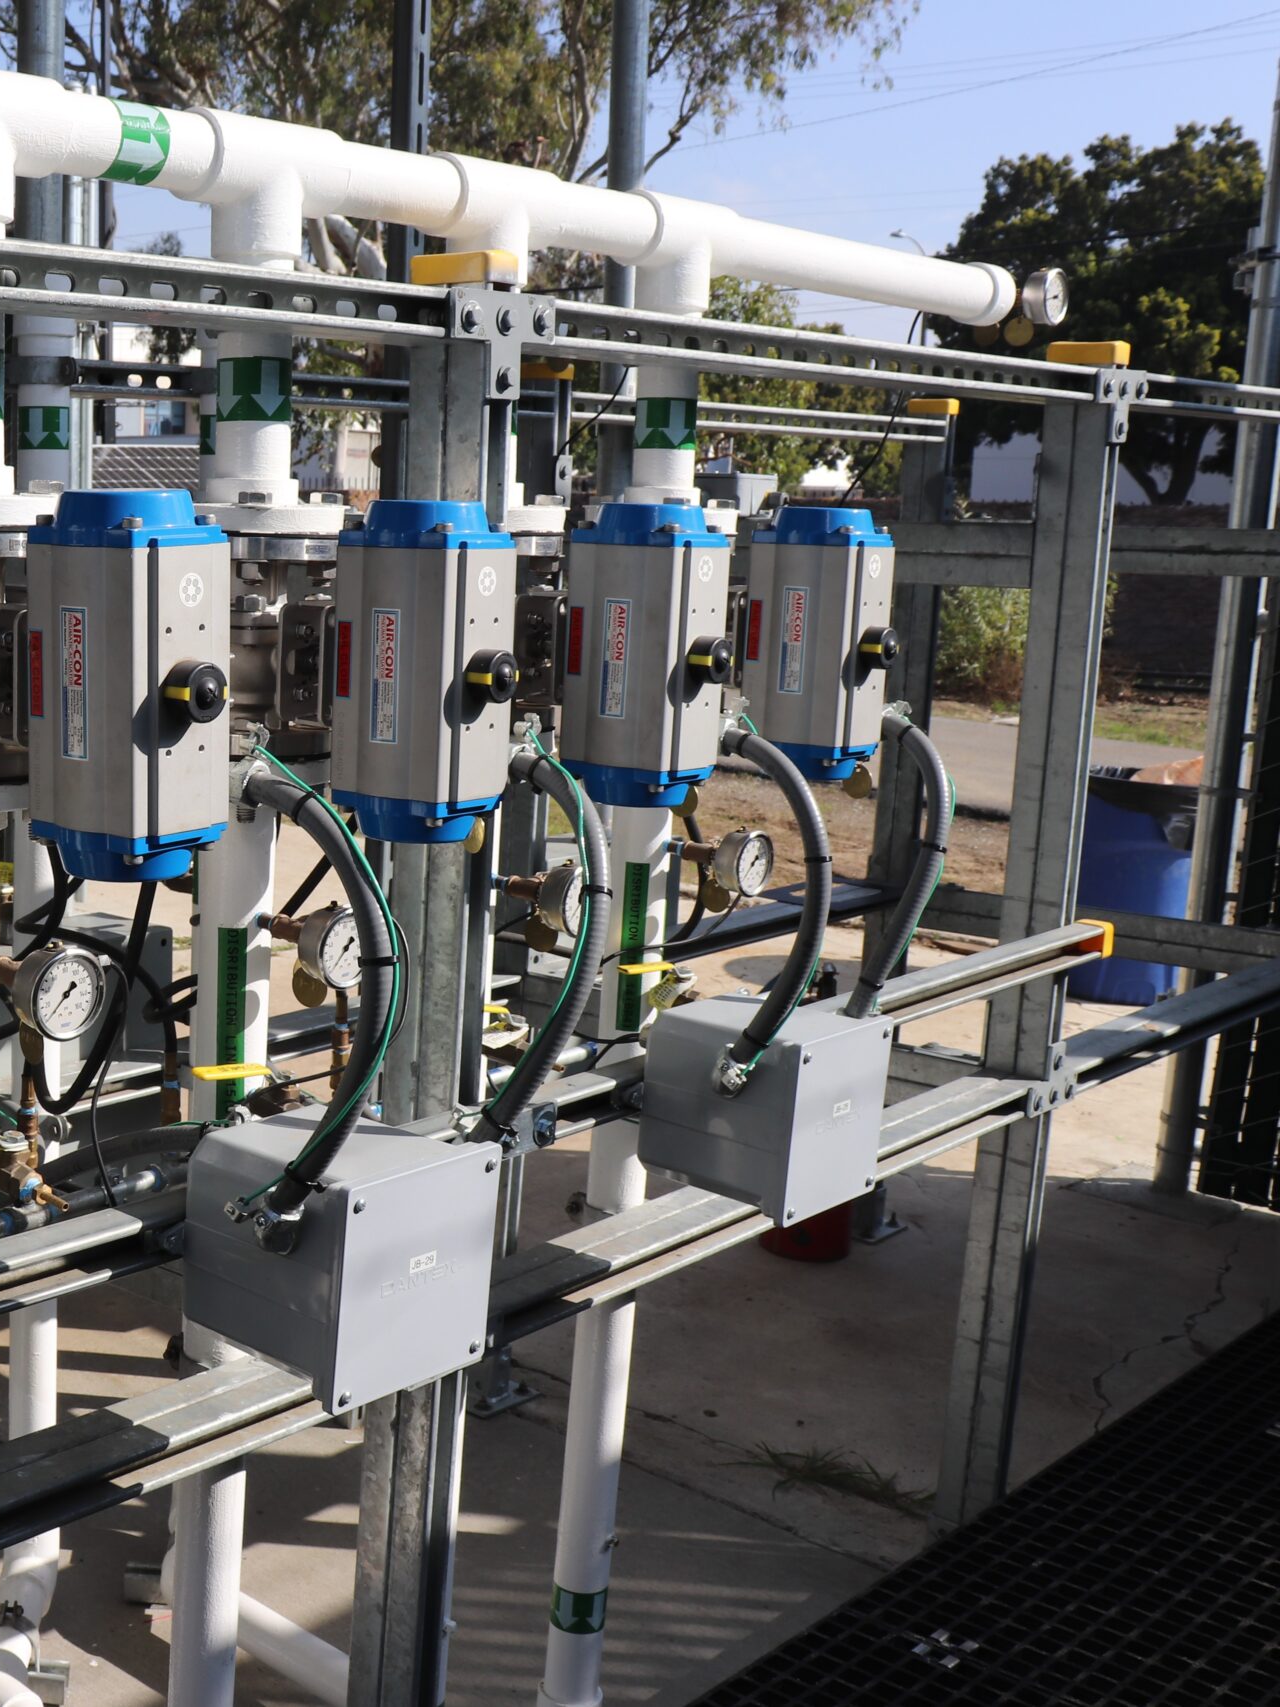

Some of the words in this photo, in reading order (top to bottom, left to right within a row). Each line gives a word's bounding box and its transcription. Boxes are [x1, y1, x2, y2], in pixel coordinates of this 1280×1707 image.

[384, 616, 395, 678] AIR-CON
[613, 606, 628, 661] AIR-CON
[792, 593, 805, 643] AIR-CON
[71, 616, 84, 686] AIR-CON
[629, 865, 643, 940] DISRIBUTION
[226, 930, 239, 1025] DISRIBUTION
[225, 1035, 237, 1065] LIN
[412, 1255, 434, 1270] JB-29
